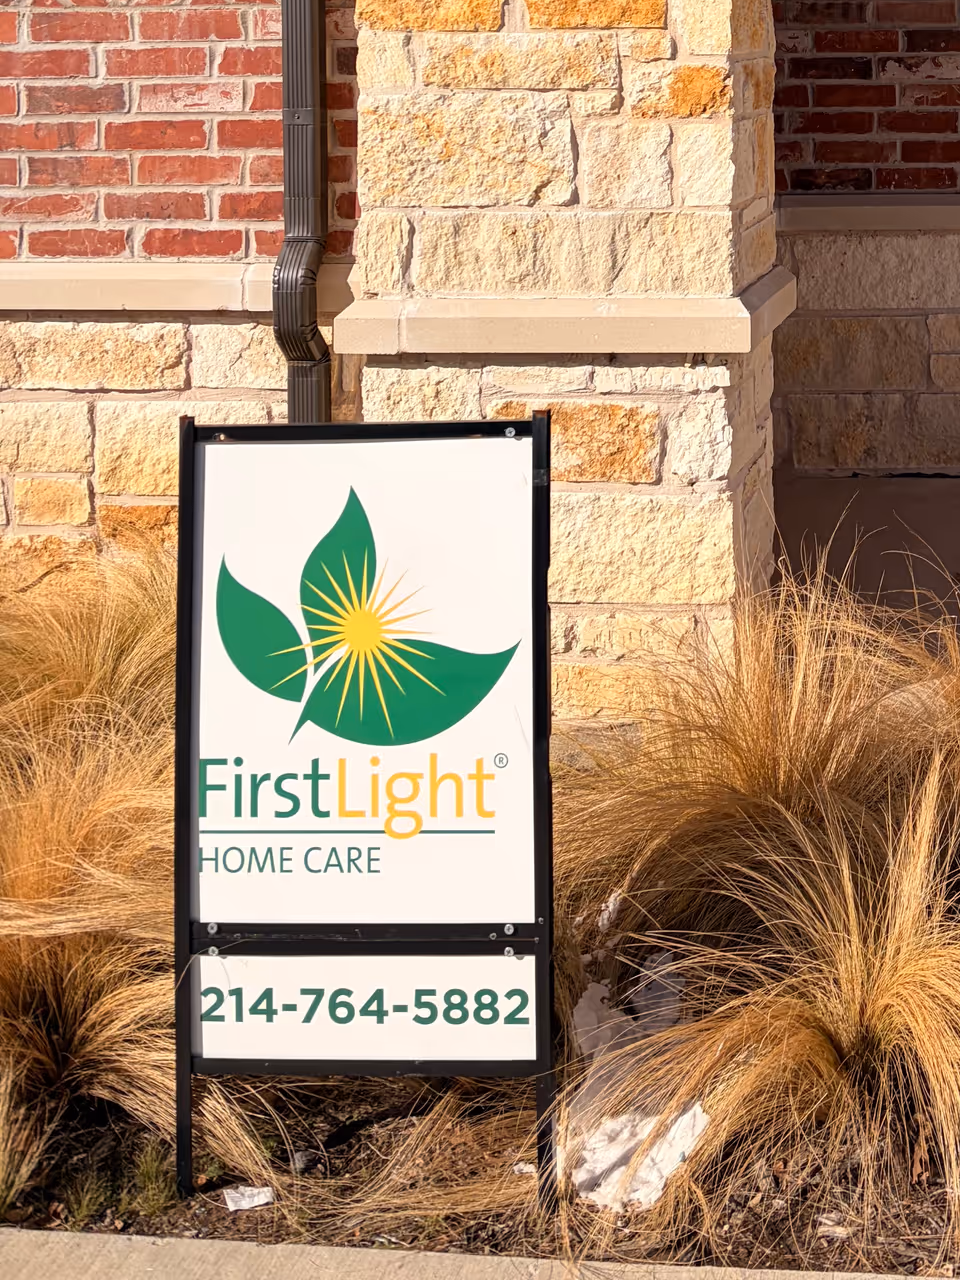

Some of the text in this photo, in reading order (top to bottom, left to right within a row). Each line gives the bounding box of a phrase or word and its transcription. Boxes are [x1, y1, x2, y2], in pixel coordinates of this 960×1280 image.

[199, 846, 381, 874] HOME CARE
[200, 986, 530, 1026] 214-764-5882
